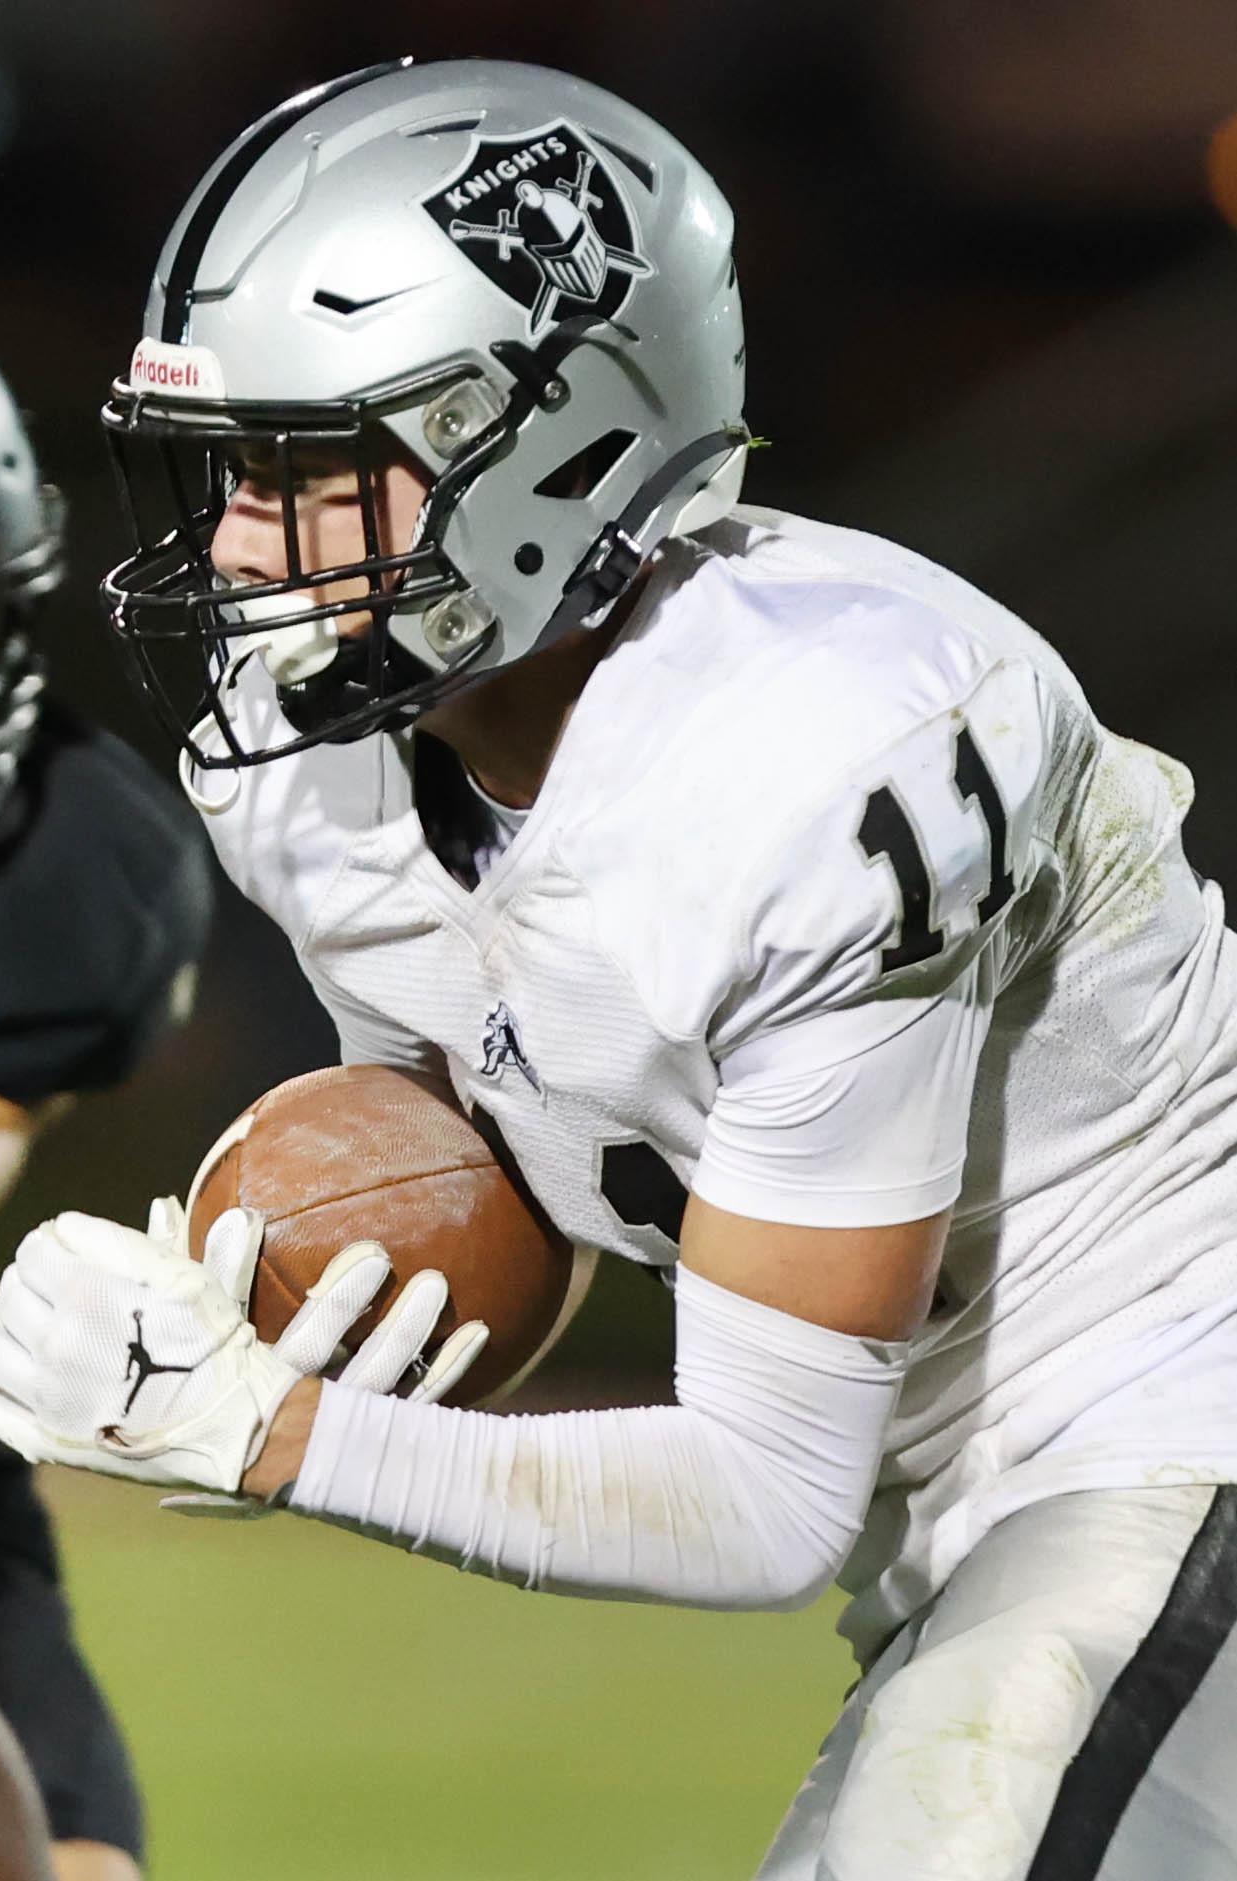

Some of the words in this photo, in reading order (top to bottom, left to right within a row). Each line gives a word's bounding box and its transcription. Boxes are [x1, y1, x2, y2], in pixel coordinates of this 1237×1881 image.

[444, 136, 567, 211] KNIGHTS
[134, 351, 199, 387] Riddell
[854, 722, 1016, 976] 11
